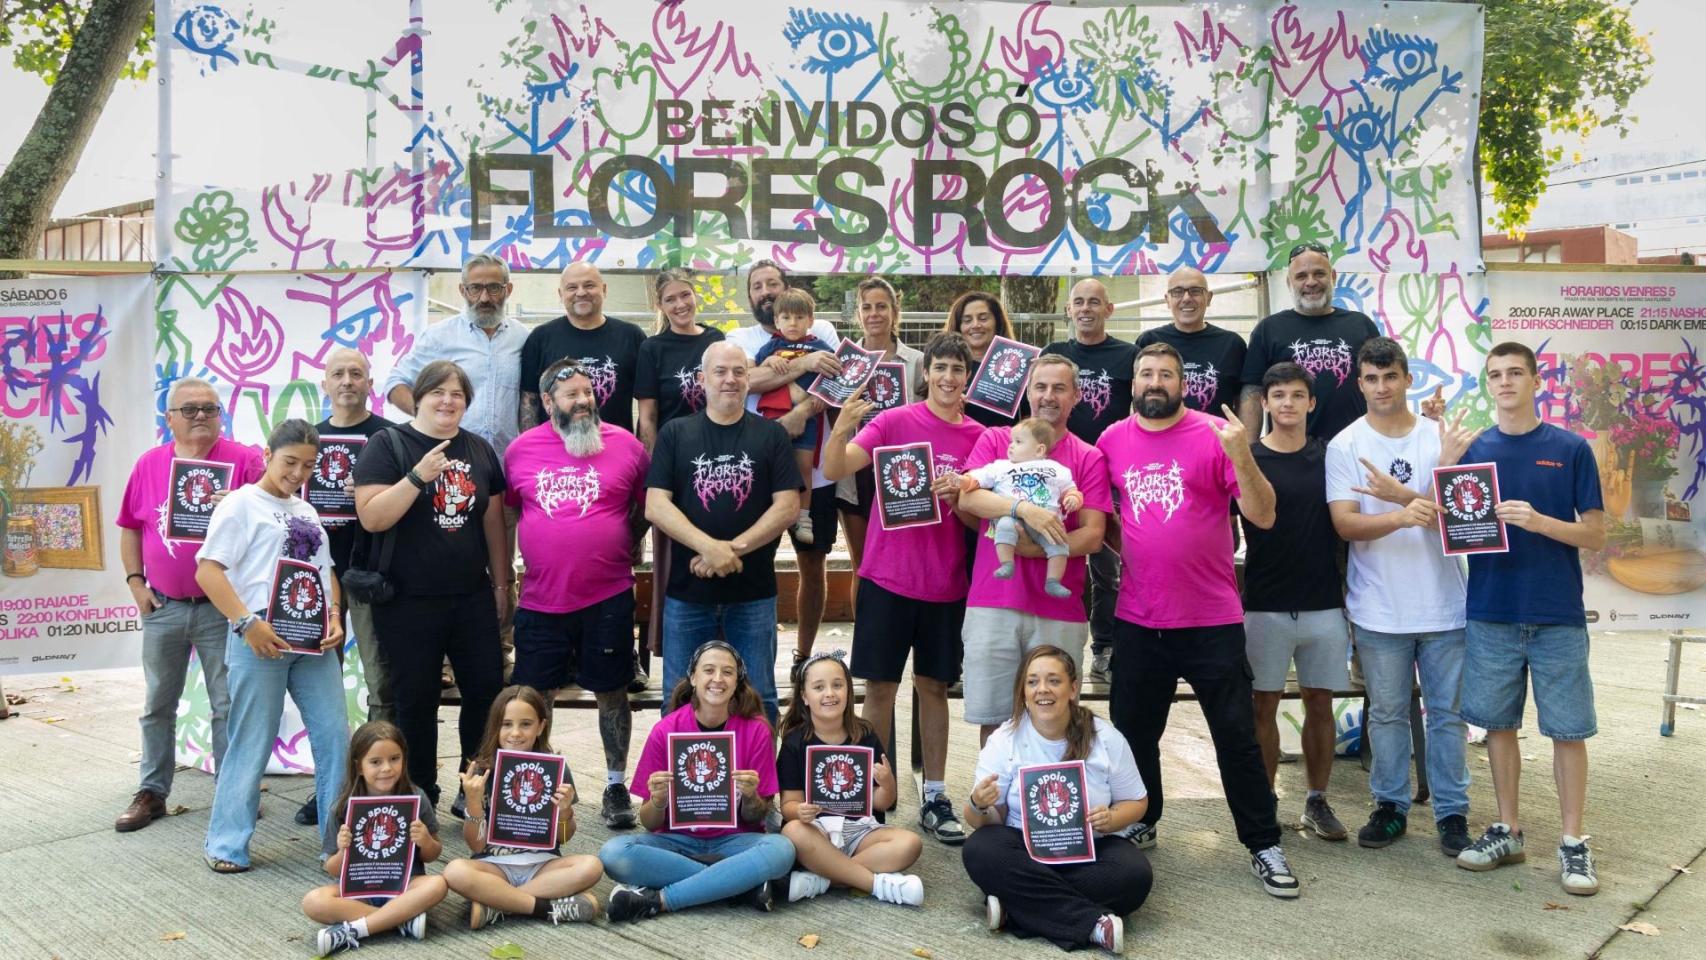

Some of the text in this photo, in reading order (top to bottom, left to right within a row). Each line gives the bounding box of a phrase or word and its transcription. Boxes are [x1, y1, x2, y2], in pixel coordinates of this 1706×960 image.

[658, 84, 1042, 149] BENVIDOS Ó
[471, 153, 1227, 248] FLORES ROCK
[0, 287, 68, 302] SÁBADO 6
[1560, 286, 1675, 297] HORARIOS VENRES 5
[1509, 307, 1634, 318] 20:00 FAR AWAY PLACE
[1640, 307, 1667, 318] 21:15
[1491, 319, 1614, 330] 22:15 DIRKSCHNEIDER
[1620, 319, 1648, 330] 00:15
[1649, 319, 1682, 330] DARK
[323, 444, 350, 454] apoio
[690, 451, 756, 479] FLORES
[883, 463, 891, 475] eu
[890, 451, 916, 464] apoio
[915, 459, 925, 471] ao
[177, 468, 222, 490] eu apoio ao
[883, 476, 927, 498] Flores Rock
[1444, 472, 1490, 497] eu apoio ao
[176, 491, 213, 513] Flores Ro
[1445, 500, 1492, 521] Flores Rock
[439, 514, 464, 525] Rock
[281, 570, 323, 596] eu apoio ao
[0, 594, 89, 611] 19:00 RAIADE
[279, 595, 323, 619] Flores Rock
[17, 612, 52, 625] 22:00
[55, 606, 138, 622] KONFLIKTO
[47, 624, 82, 637] 01:20
[677, 740, 726, 766] eu apoio ao
[503, 762, 553, 787] eu apoio ao
[815, 753, 863, 777] eu apoio ao
[677, 770, 727, 793] Flores Rock
[815, 778, 864, 800] Flores Rock
[1029, 771, 1078, 798] eu apoio ao
[502, 789, 552, 814] Flores Rock
[355, 804, 407, 830] eu apoio ao
[1030, 802, 1080, 827] Flores Rock
[354, 836, 406, 860] Flores Rock
